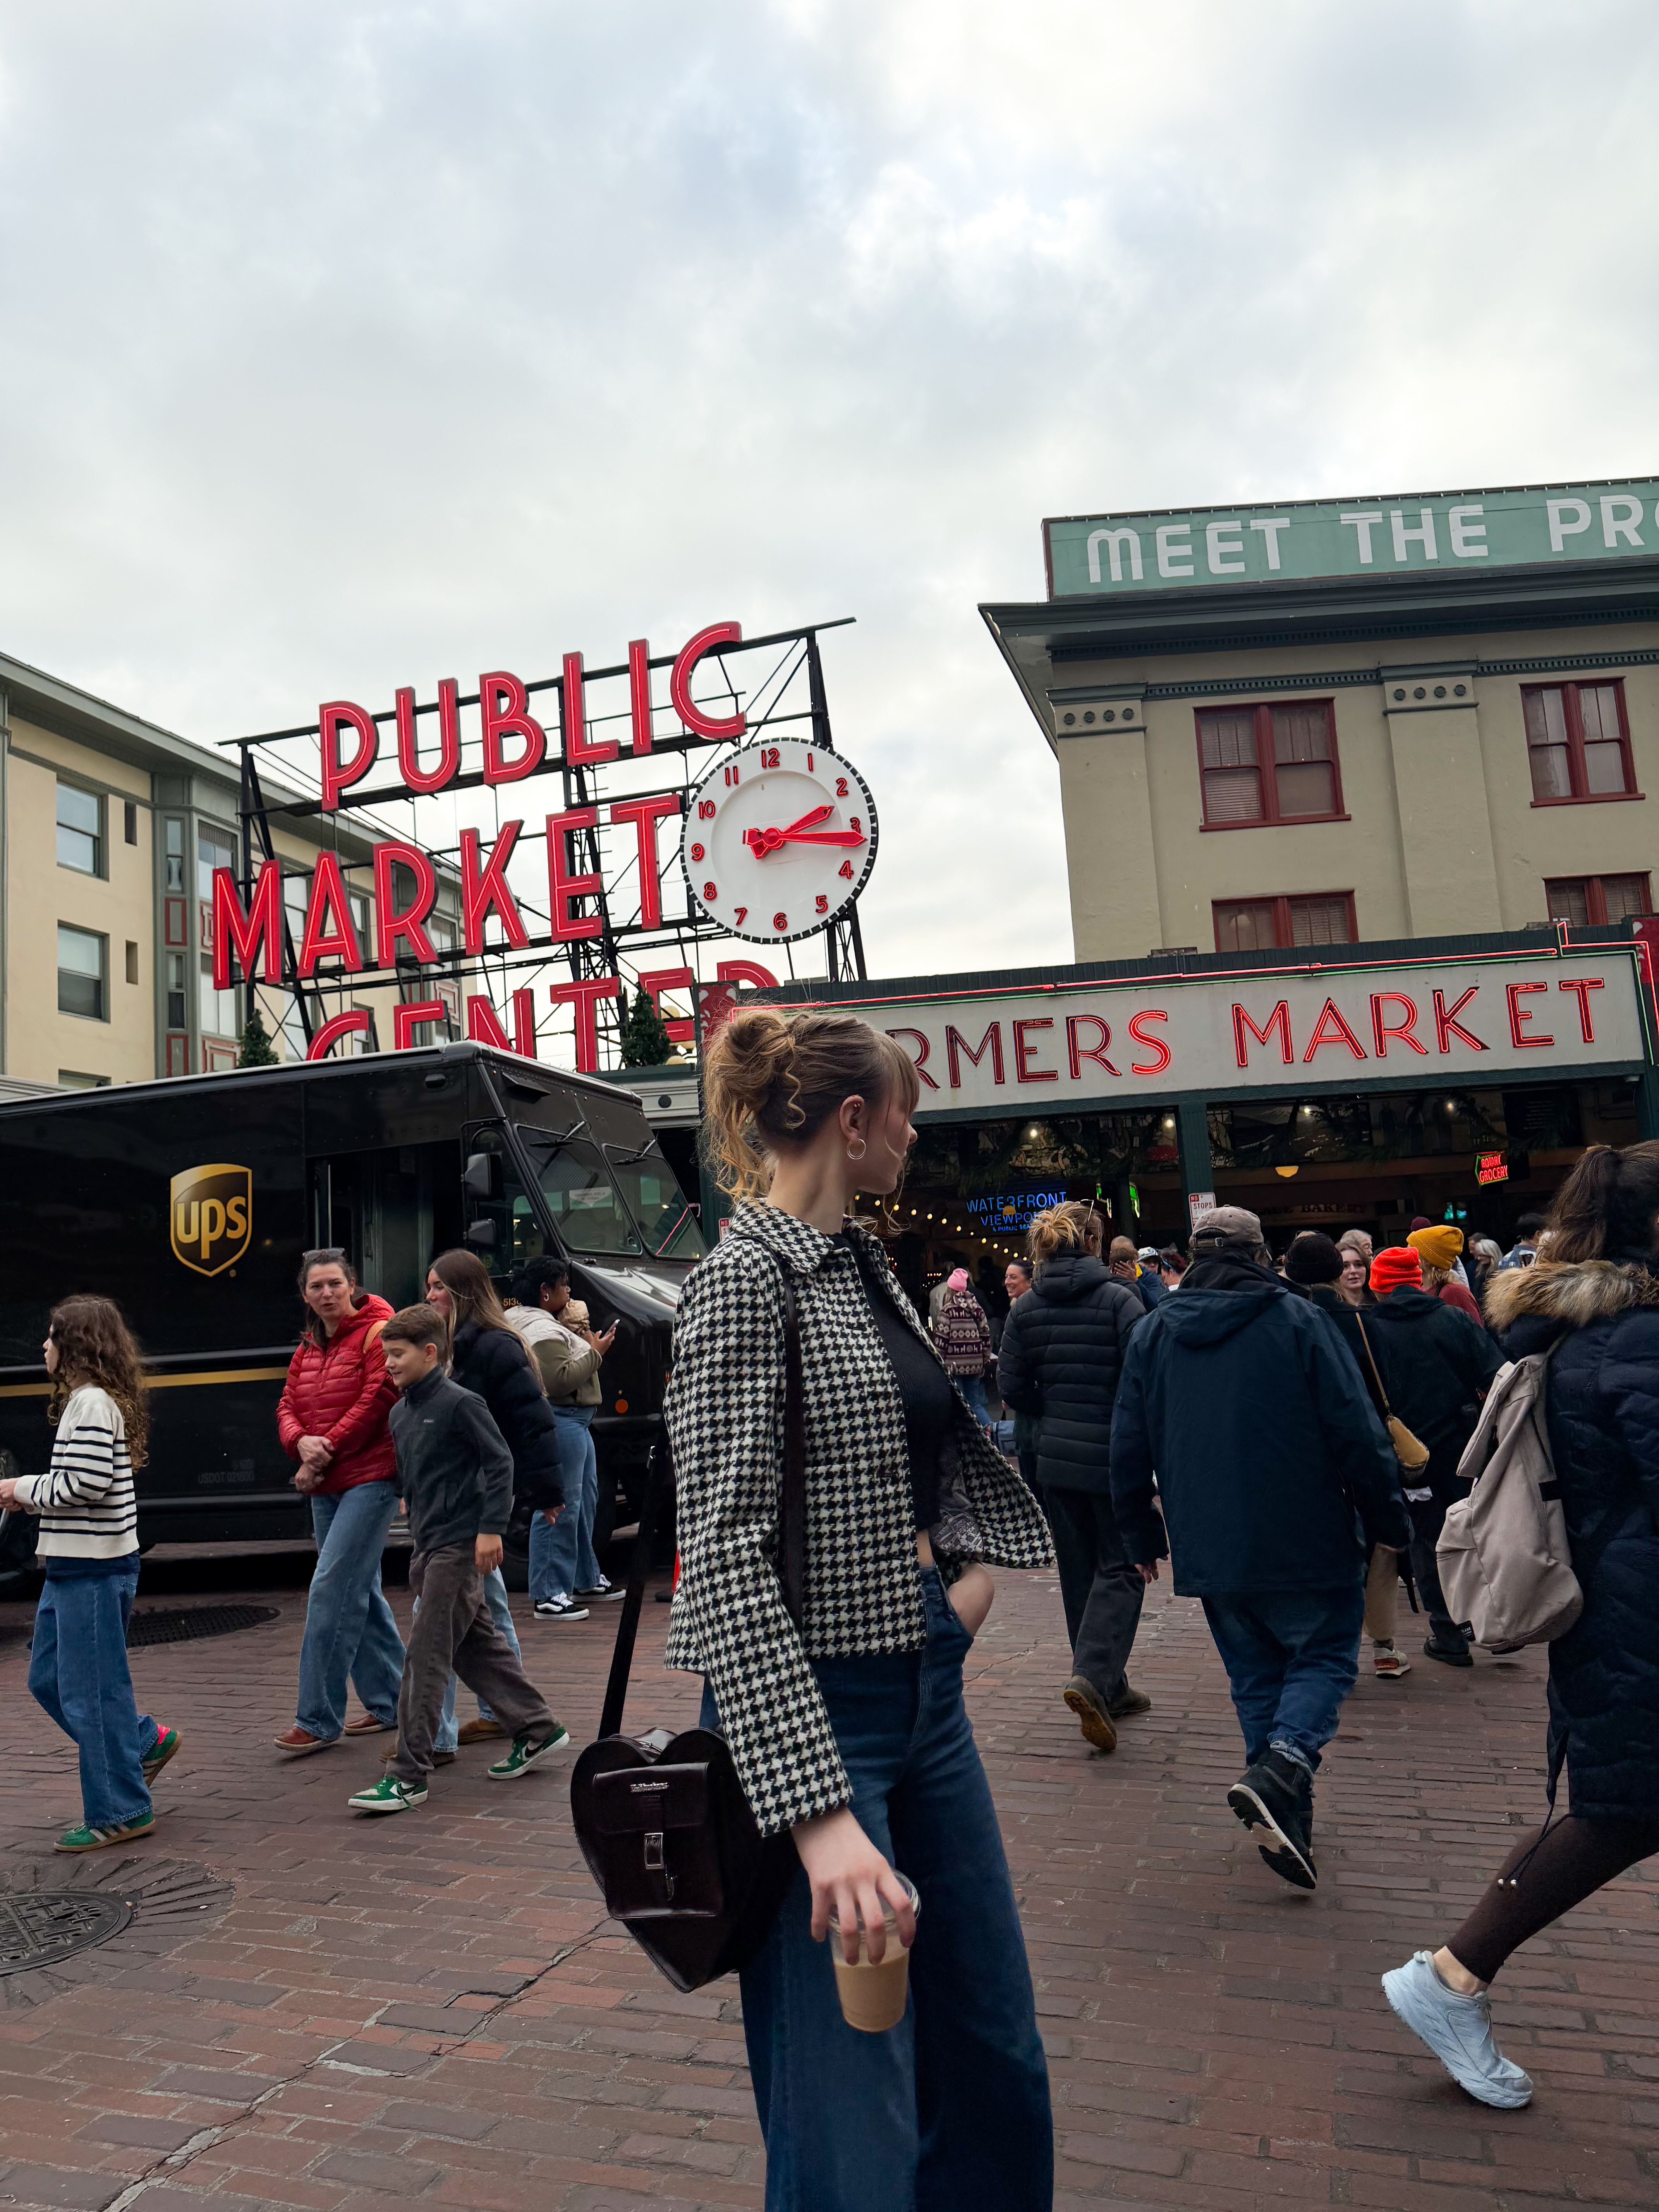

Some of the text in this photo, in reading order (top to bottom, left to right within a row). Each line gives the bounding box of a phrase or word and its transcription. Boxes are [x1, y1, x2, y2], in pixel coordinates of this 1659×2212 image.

[1087, 494, 1659, 583] MEET THE PR
[319, 620, 747, 811] PUBLIC
[761, 748, 780, 768] 12
[807, 752, 814, 772] 1
[725, 765, 739, 786] 11
[836, 778, 848, 797] 2
[698, 800, 716, 819] 10
[691, 843, 705, 861] 9
[838, 860, 854, 879] 4
[212, 793, 680, 990] MARKET
[704, 882, 717, 900] 8
[816, 895, 828, 914] 5
[734, 907, 748, 926] 7
[773, 912, 788, 931] 6
[885, 977, 1605, 1091] RMERS MARKET
[1479, 1165, 1508, 1183] GROCERY
[967, 1192, 1066, 1212] WATERFRONT
[1301, 1204, 1366, 1212] BAKERY
[981, 1212, 1038, 1226] VIEWPO
